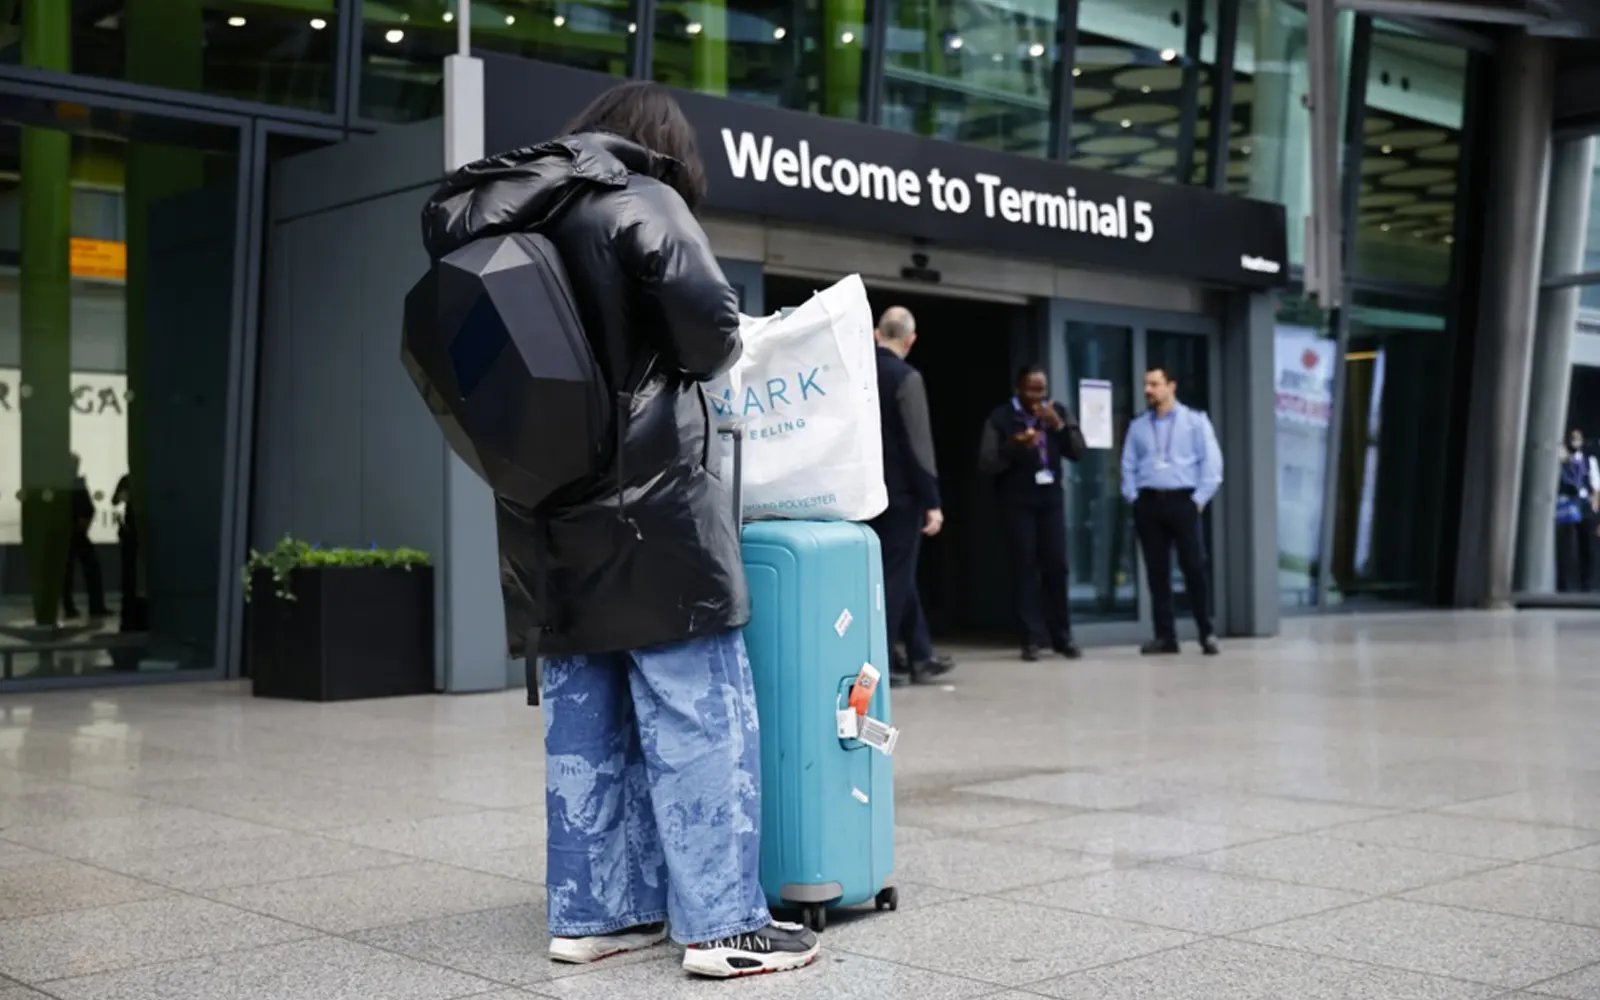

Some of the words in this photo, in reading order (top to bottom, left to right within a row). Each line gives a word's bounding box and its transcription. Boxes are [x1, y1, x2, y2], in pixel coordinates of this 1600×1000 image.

[721, 127, 921, 207] Welcome
[926, 168, 970, 214] to
[974, 172, 1127, 239] Terminal
[1133, 200, 1154, 243] 5
[749, 418, 806, 440] EELING
